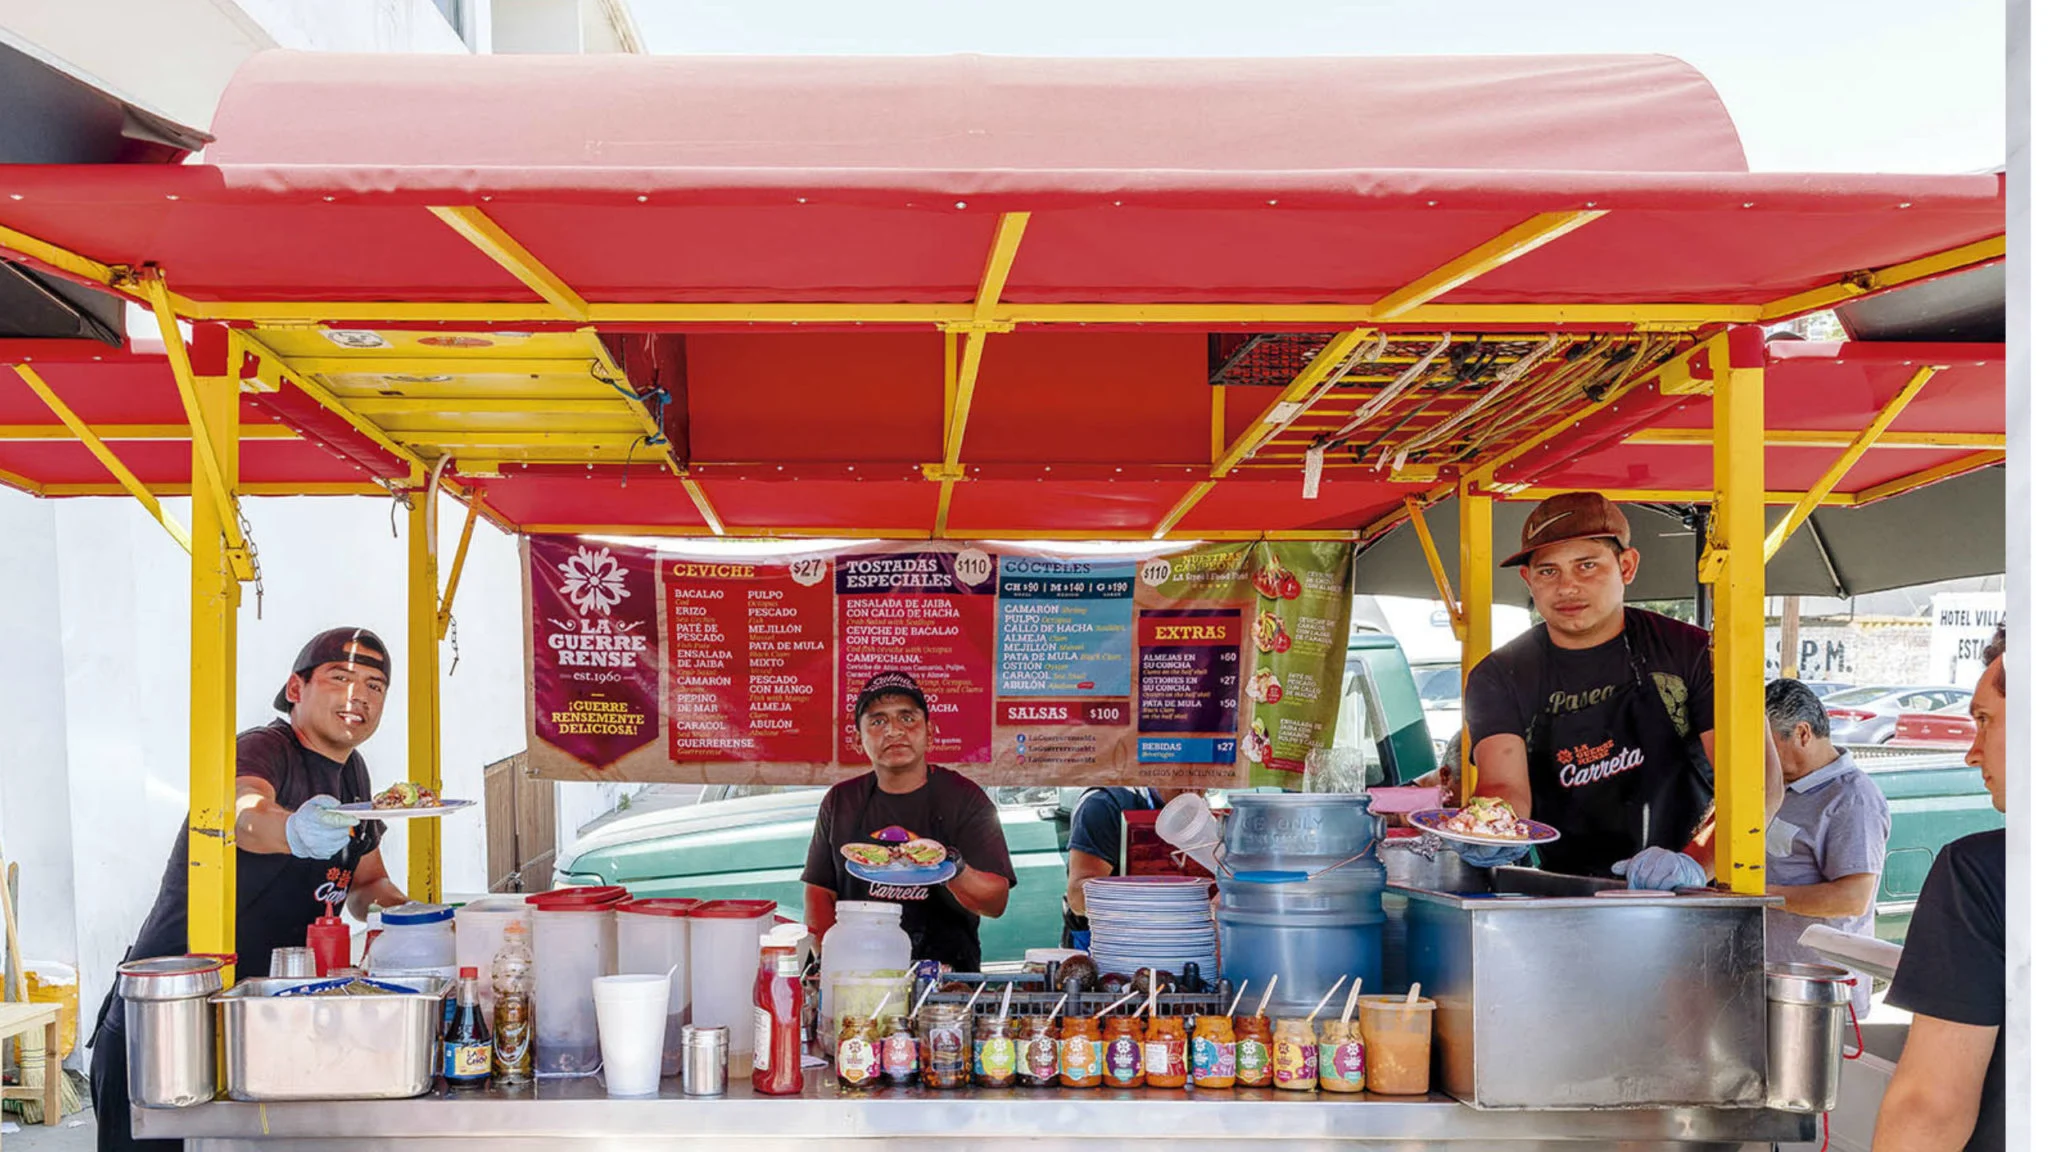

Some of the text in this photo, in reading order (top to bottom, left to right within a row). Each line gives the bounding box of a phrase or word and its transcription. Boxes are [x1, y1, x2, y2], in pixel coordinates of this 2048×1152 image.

[673, 564, 755, 578] CEVICHE
[794, 559, 822, 577] $27
[847, 559, 986, 574] TOSTADAS $110
[1005, 559, 1091, 574] CÓCTELES
[1144, 566, 1168, 580] $110
[847, 574, 952, 587] ESPECIALES
[1004, 582, 1021, 591] CH
[1023, 582, 1039, 592] $90
[1050, 583, 1062, 591] M
[1064, 582, 1085, 592] $140
[1108, 582, 1128, 592] $190
[675, 589, 724, 599] BACALAO
[748, 590, 783, 600] PULPO
[847, 599, 952, 608] ENSALADA DE JAIBA
[675, 607, 707, 615] ERIZO
[748, 608, 797, 617] PESCADO
[846, 609, 960, 618] CON CALLO DE HACHA
[1004, 604, 1059, 614] CAMARÓN
[1004, 615, 1040, 623] PULPO
[1940, 610, 1970, 626] HOTEL
[581, 619, 611, 634] LA
[704, 624, 718, 633] DE
[748, 623, 802, 633] MEJILLÓN
[846, 626, 959, 636] CEVICHE DE BACALAO
[1004, 624, 1093, 633] CALLO DE HACHA
[1155, 625, 1226, 640] EXTRAS
[677, 633, 725, 642] PESCADO
[846, 636, 906, 645] CON PULPO
[1004, 634, 1047, 642] ALMEJA
[548, 634, 646, 651] GUERRE
[749, 641, 824, 651] PATA DE MULA
[1004, 642, 1056, 651] MEJILLÓN
[558, 650, 636, 667] RENSE
[677, 650, 733, 659] ENSALADA
[846, 654, 923, 663] CAMPECHANA:
[1003, 652, 1078, 661] PATA DE MULA
[1220, 653, 1236, 661] $60
[677, 659, 724, 668] DE JAIBA
[749, 658, 784, 667] MIXTO
[1003, 661, 1042, 670] OSTIÓN
[1143, 661, 1191, 669] SU CONCHA
[573, 671, 621, 682] est.1960
[677, 675, 731, 685] CAMARÓN
[750, 675, 798, 684] PESCADO
[1003, 671, 1050, 680] CARACOL
[1220, 676, 1236, 684] $27
[1003, 680, 1045, 689] ABULÓN
[749, 685, 813, 694] CON MANGO
[678, 694, 717, 703] PEPINO
[569, 701, 628, 713] ¡GUERRE
[678, 704, 718, 712] DE MAR
[750, 702, 792, 711] ALMEJA
[1177, 700, 1202, 708] MULA
[1220, 700, 1236, 708] $50
[1008, 707, 1119, 719] SALSAS $100
[552, 712, 645, 725] RENSEMENTE
[677, 721, 726, 730] CARACOL
[750, 718, 792, 729] ABULÓN
[559, 723, 637, 735] DELICIOSA!
[677, 738, 754, 748] GUERRERENSE
[1142, 742, 1234, 751] BEBIDAS $27
[1574, 744, 1588, 753] LA
[1560, 746, 1644, 788] Carreta
[869, 881, 929, 900] Carreta
